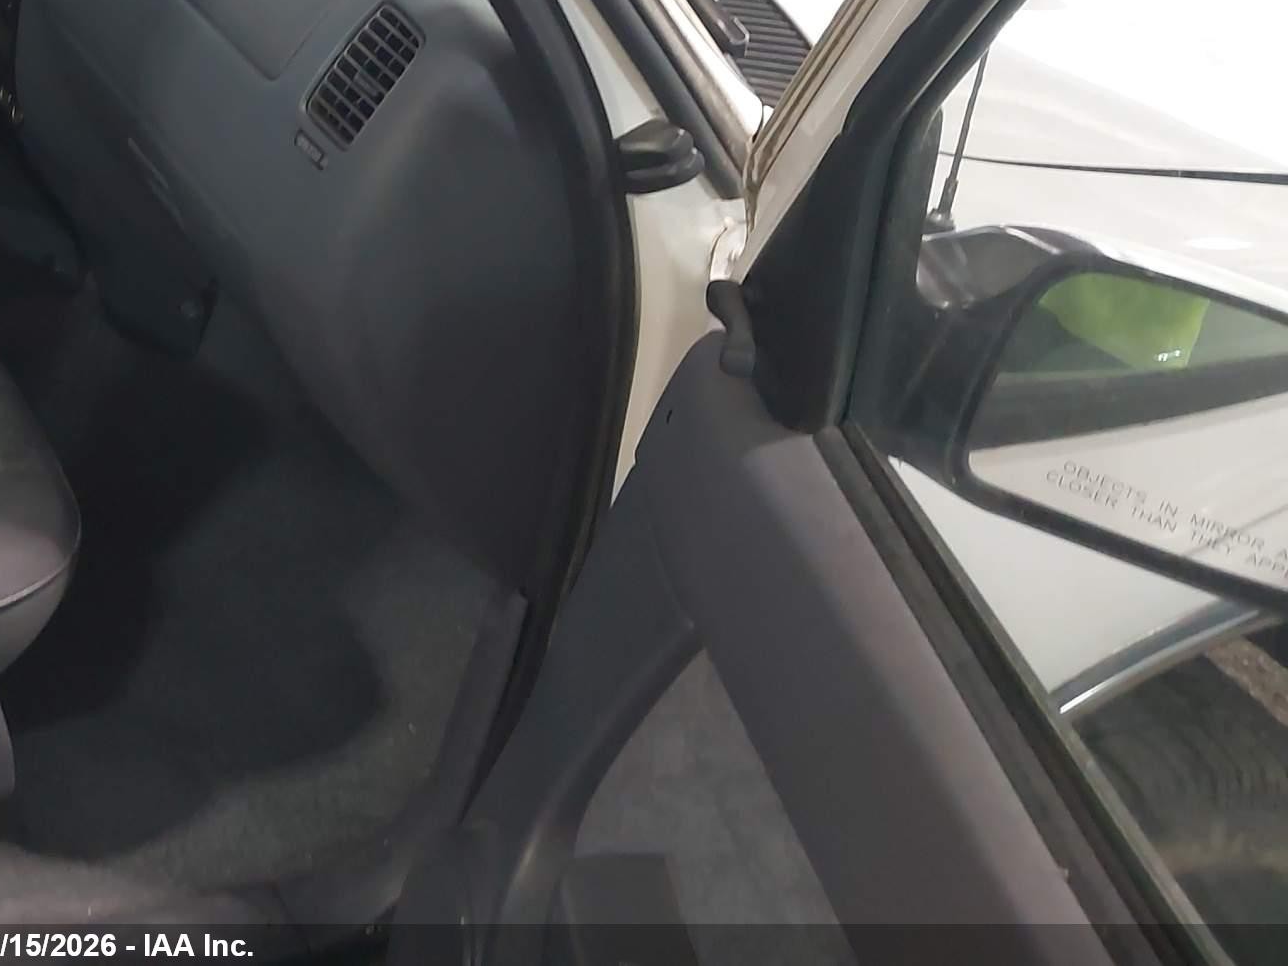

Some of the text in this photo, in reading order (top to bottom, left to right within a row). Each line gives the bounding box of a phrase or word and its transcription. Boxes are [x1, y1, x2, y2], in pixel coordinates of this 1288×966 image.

[1046, 468, 1118, 509] CLOSER
[1131, 505, 1177, 533] THAN
[1192, 530, 1231, 555] THEY
[1063, 460, 1147, 504] OBJECTS
[1159, 499, 1178, 517] IN
[1191, 513, 1265, 551] MIRROR
